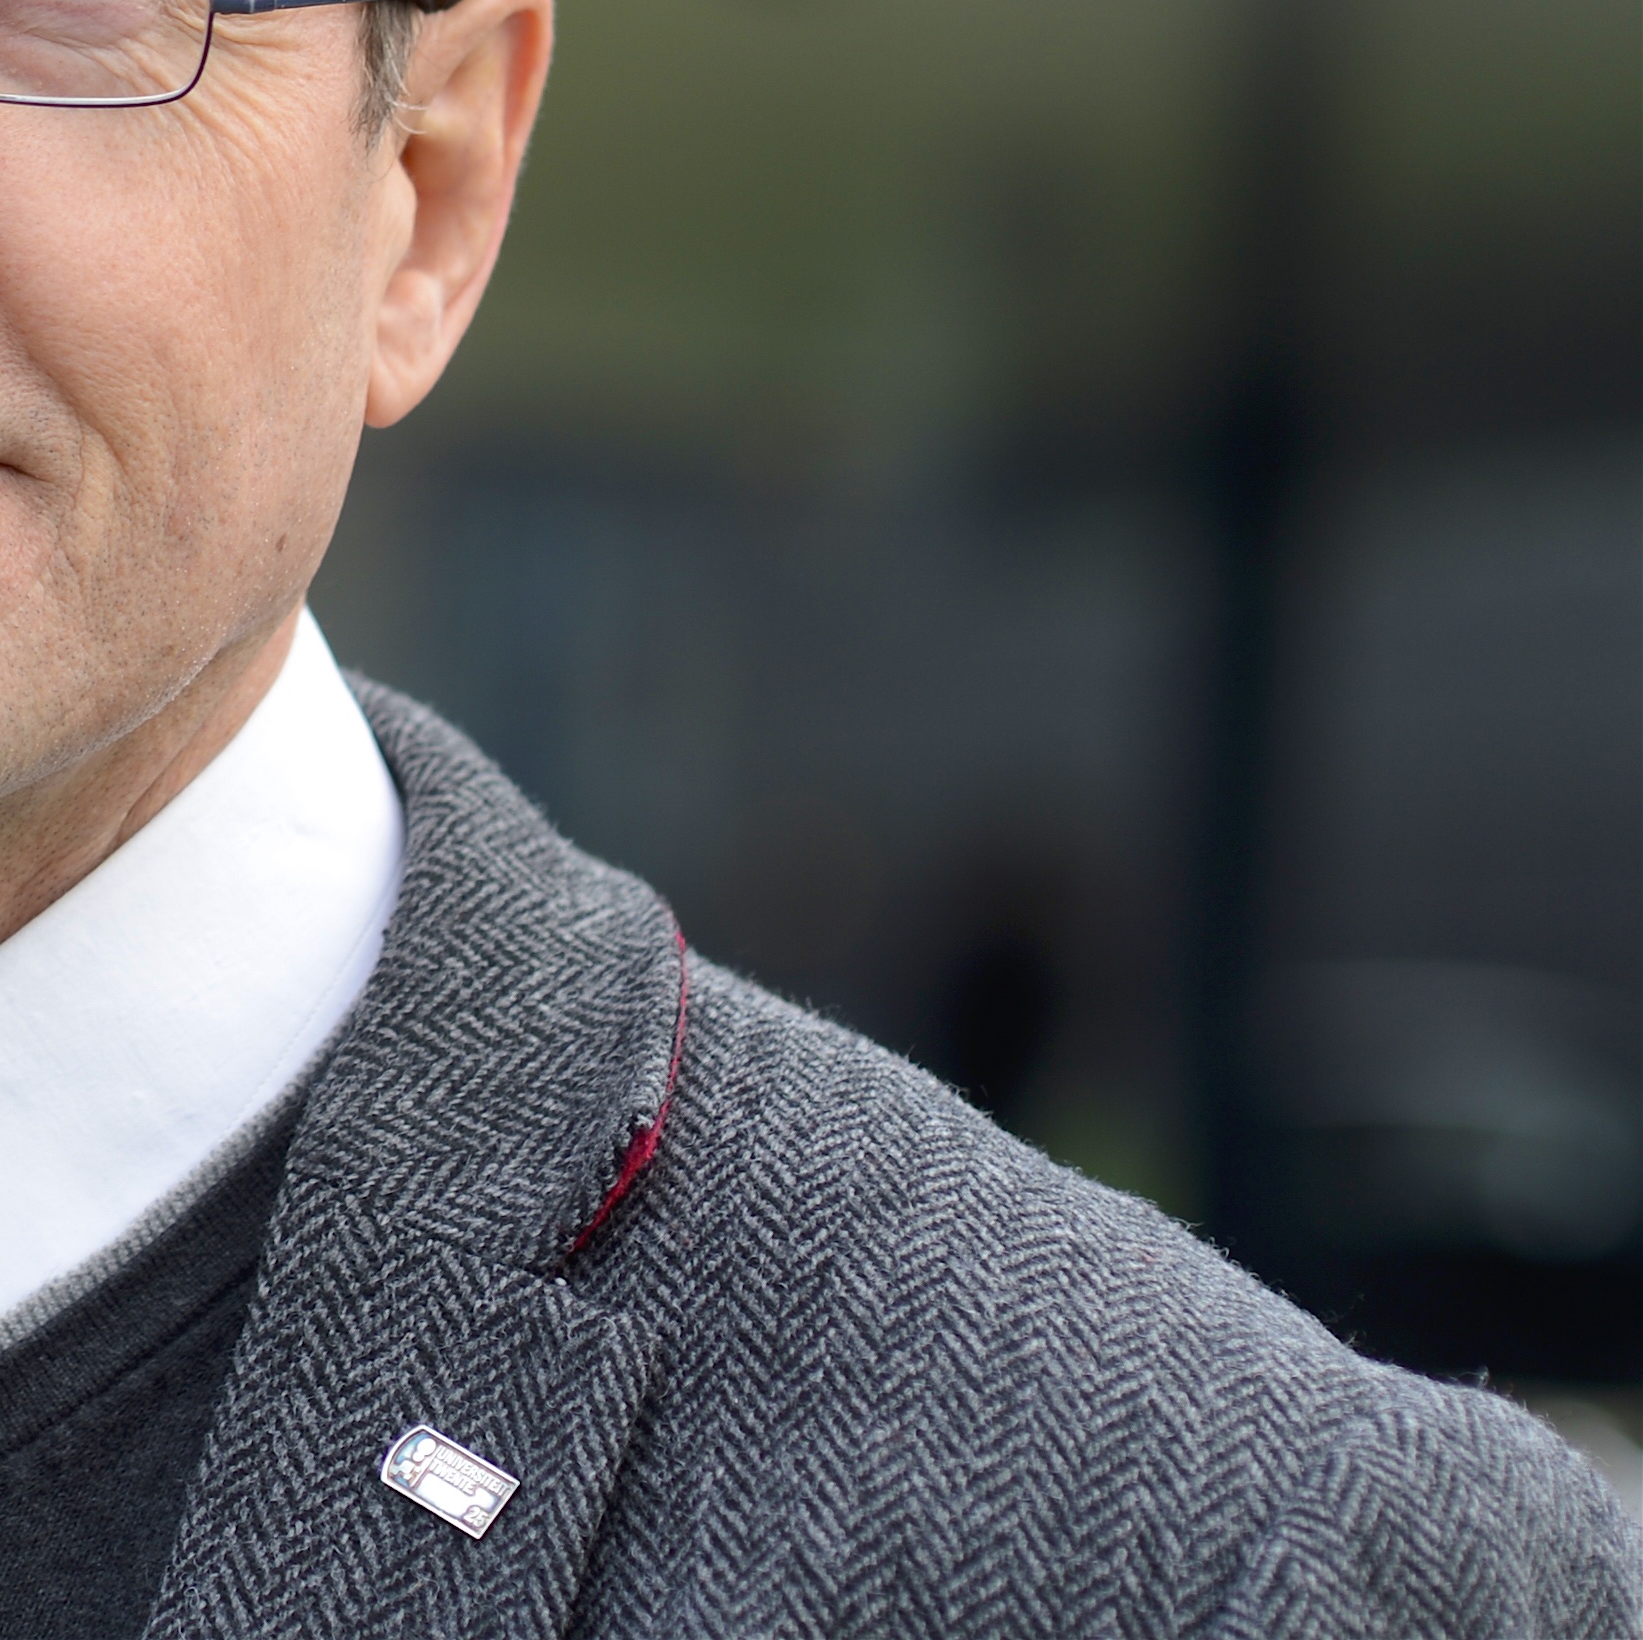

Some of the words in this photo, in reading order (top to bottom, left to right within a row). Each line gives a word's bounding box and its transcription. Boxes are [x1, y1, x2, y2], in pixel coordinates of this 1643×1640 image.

[429, 1460, 475, 1495] TWENTE
[437, 1445, 509, 1496] UNIVERSITEIT
[463, 1506, 489, 1527] 25
